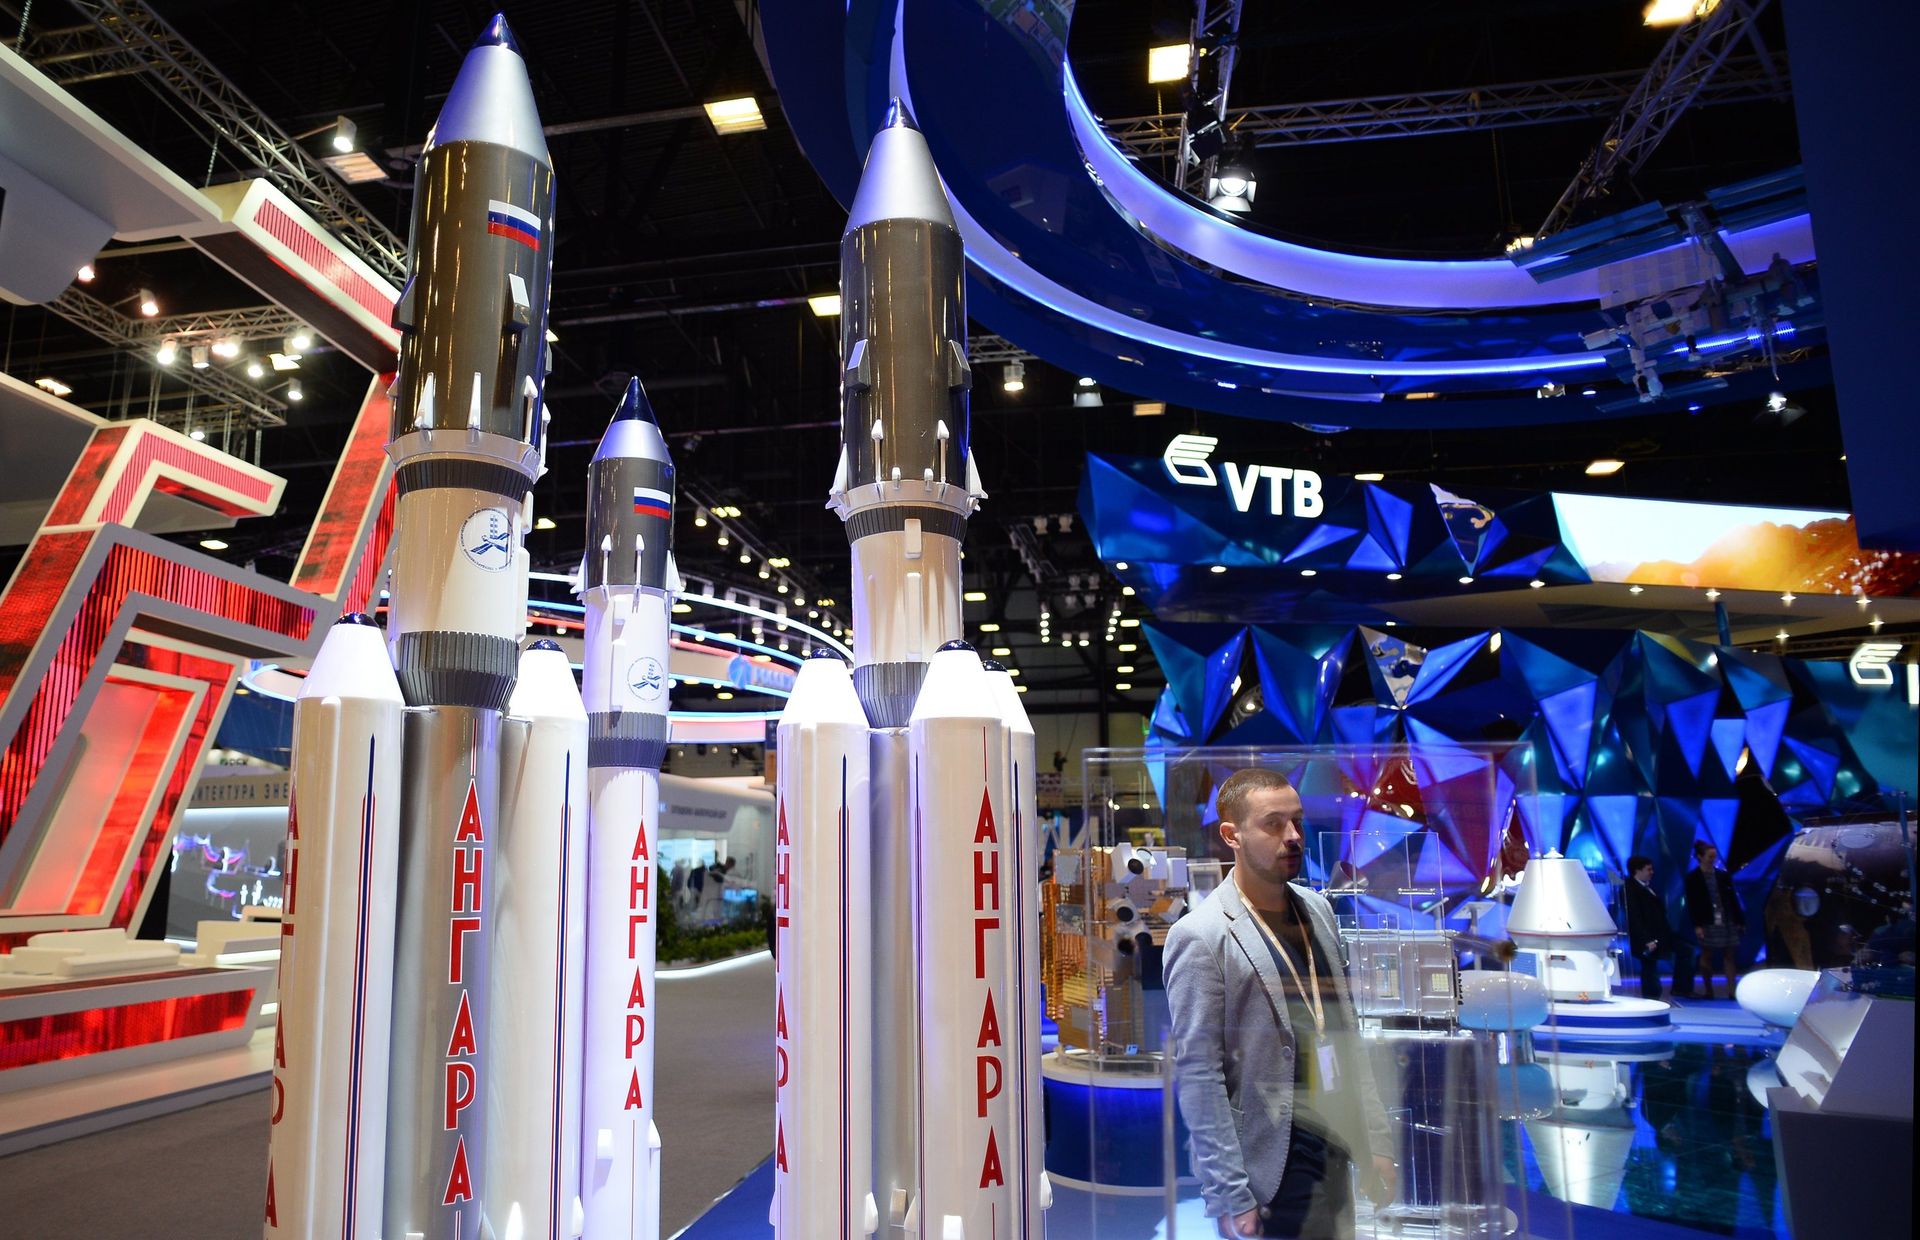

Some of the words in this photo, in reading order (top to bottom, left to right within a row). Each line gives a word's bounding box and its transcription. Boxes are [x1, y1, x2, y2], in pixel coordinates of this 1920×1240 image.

[1224, 462, 1323, 518] VTB
[191, 784, 257, 800] ИТЕКТУРА
[443, 780, 484, 1206] АНГАРА
[624, 820, 649, 1110] АНГАРА
[973, 785, 1004, 1190] АНГАРА
